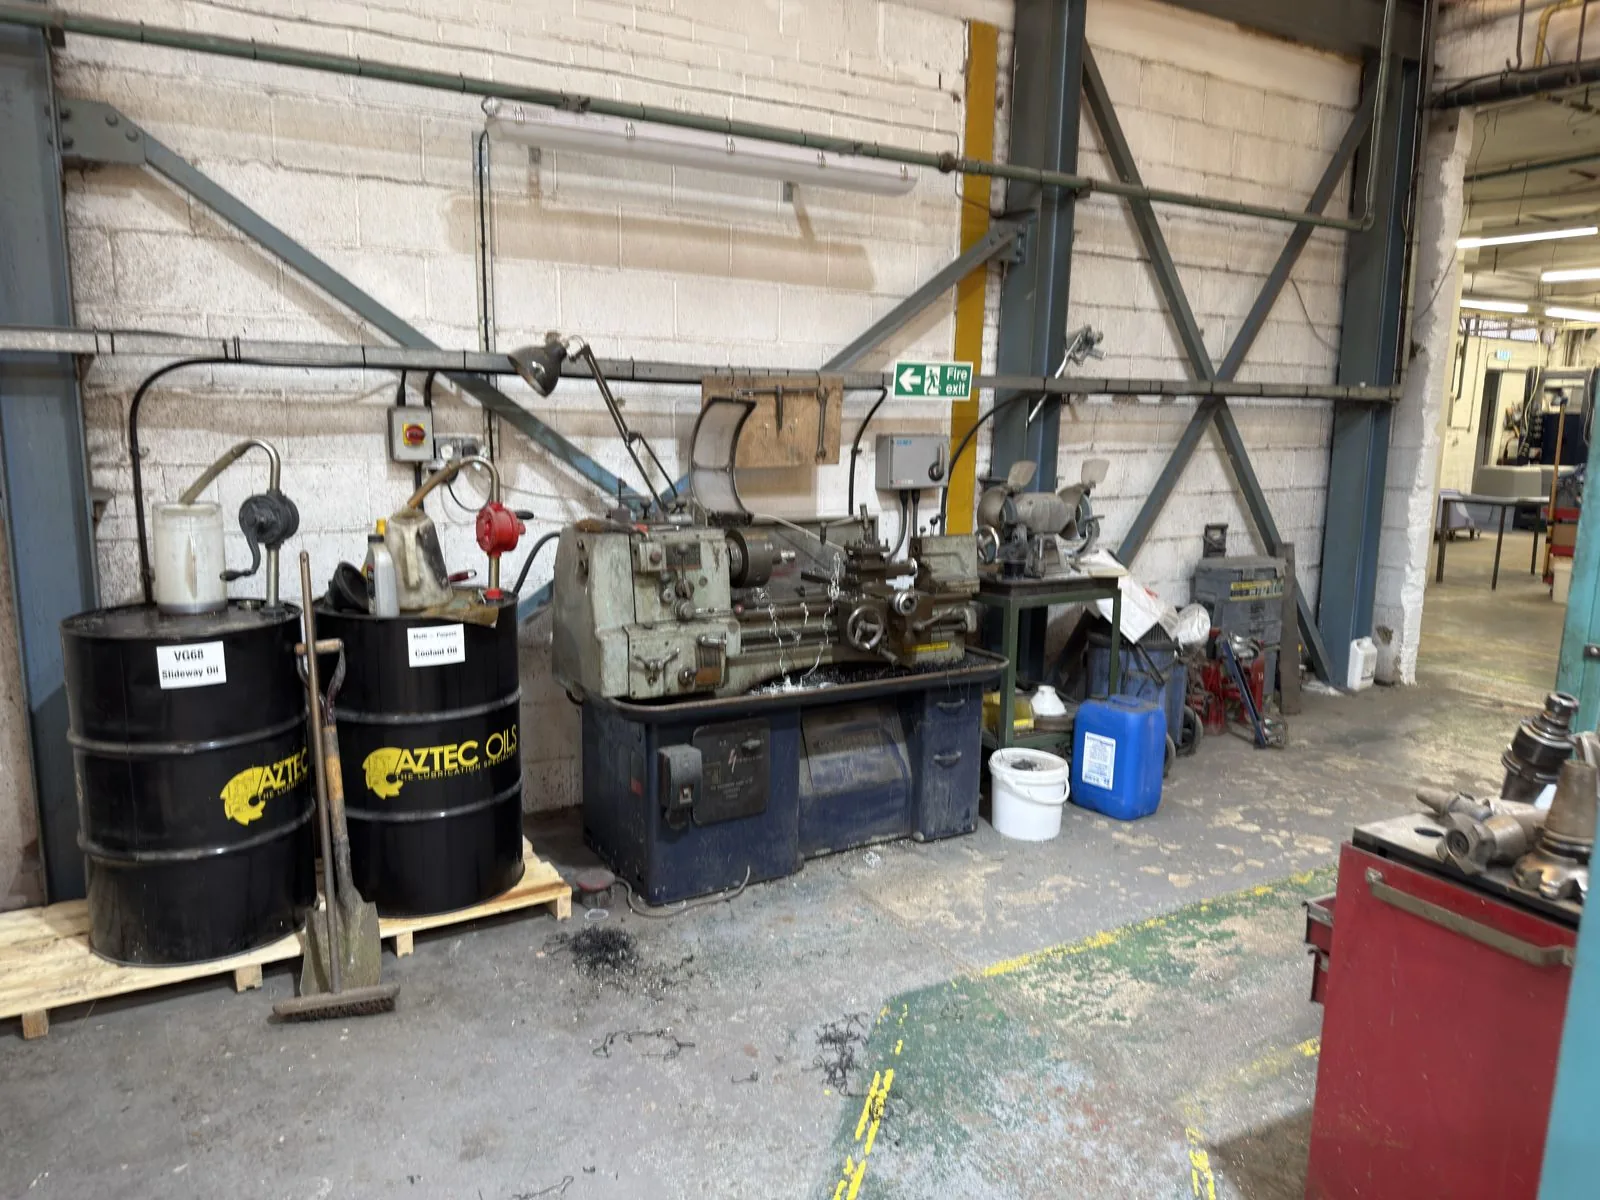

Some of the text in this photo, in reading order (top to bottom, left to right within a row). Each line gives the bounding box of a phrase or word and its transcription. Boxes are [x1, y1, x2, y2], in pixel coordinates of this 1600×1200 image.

[946, 367, 968, 381] Fire
[945, 381, 966, 395] exit
[162, 664, 219, 679] Slideway Oil
[395, 724, 516, 774] AZTEC OILS
[258, 747, 308, 796] AZTEC
[418, 763, 481, 780] LUBRICATION
